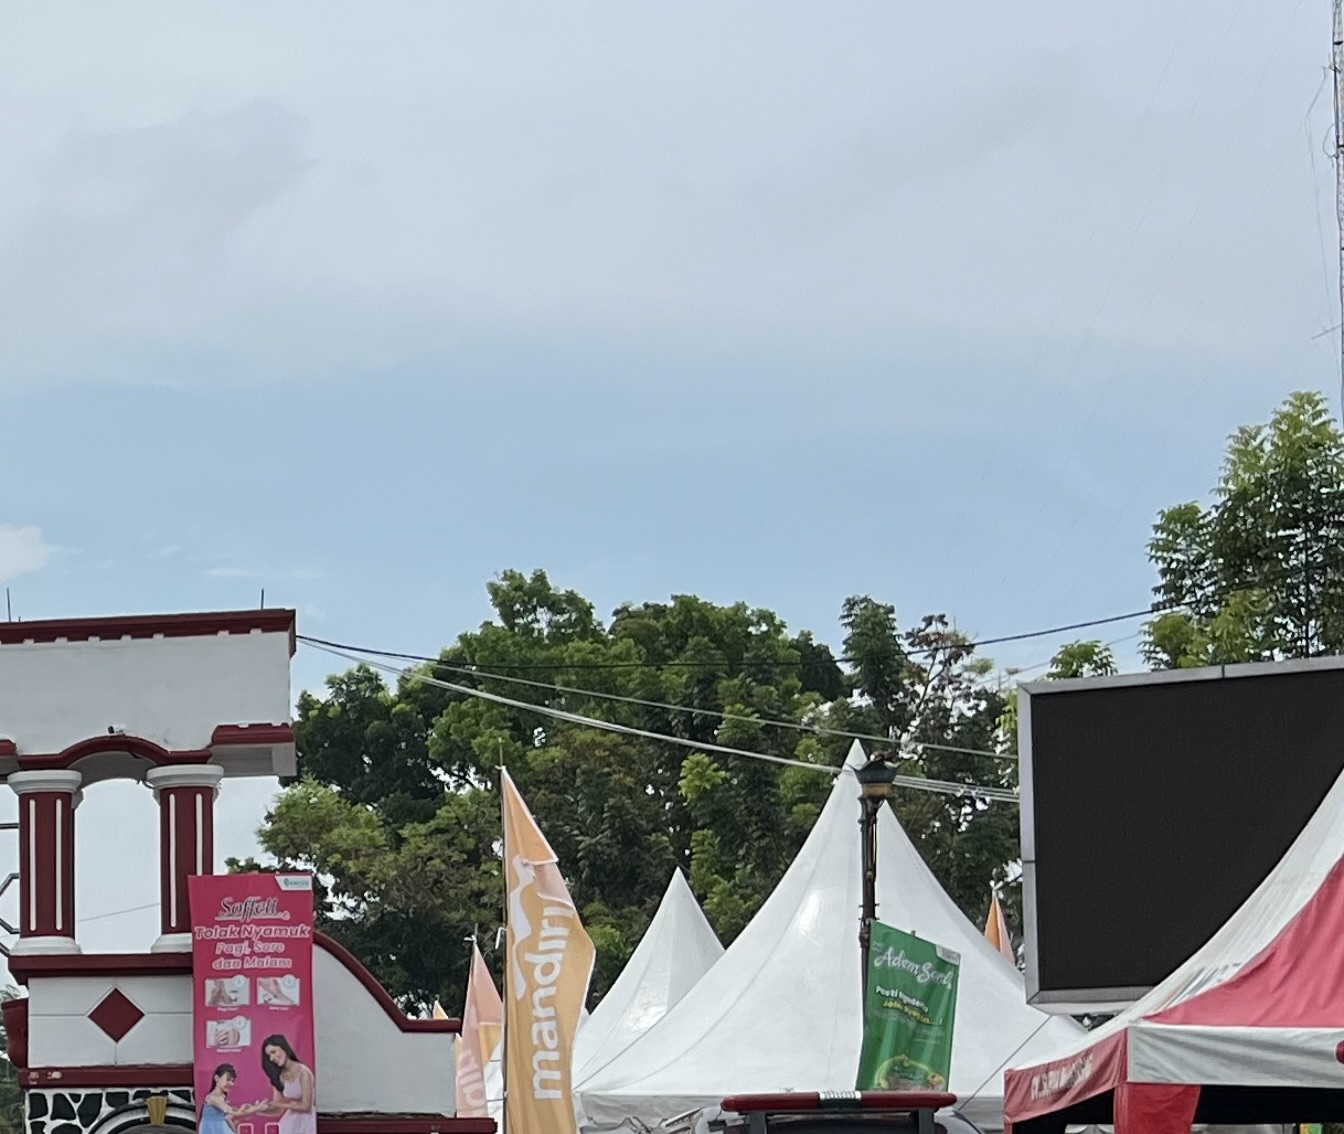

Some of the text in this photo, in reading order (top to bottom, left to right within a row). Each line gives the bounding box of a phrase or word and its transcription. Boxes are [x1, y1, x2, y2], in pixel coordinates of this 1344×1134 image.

[219, 896, 280, 922] Soffell
[194, 924, 310, 941] Tolak Nyamuk
[254, 941, 285, 953] Sore
[212, 956, 292, 970] dan Malam
